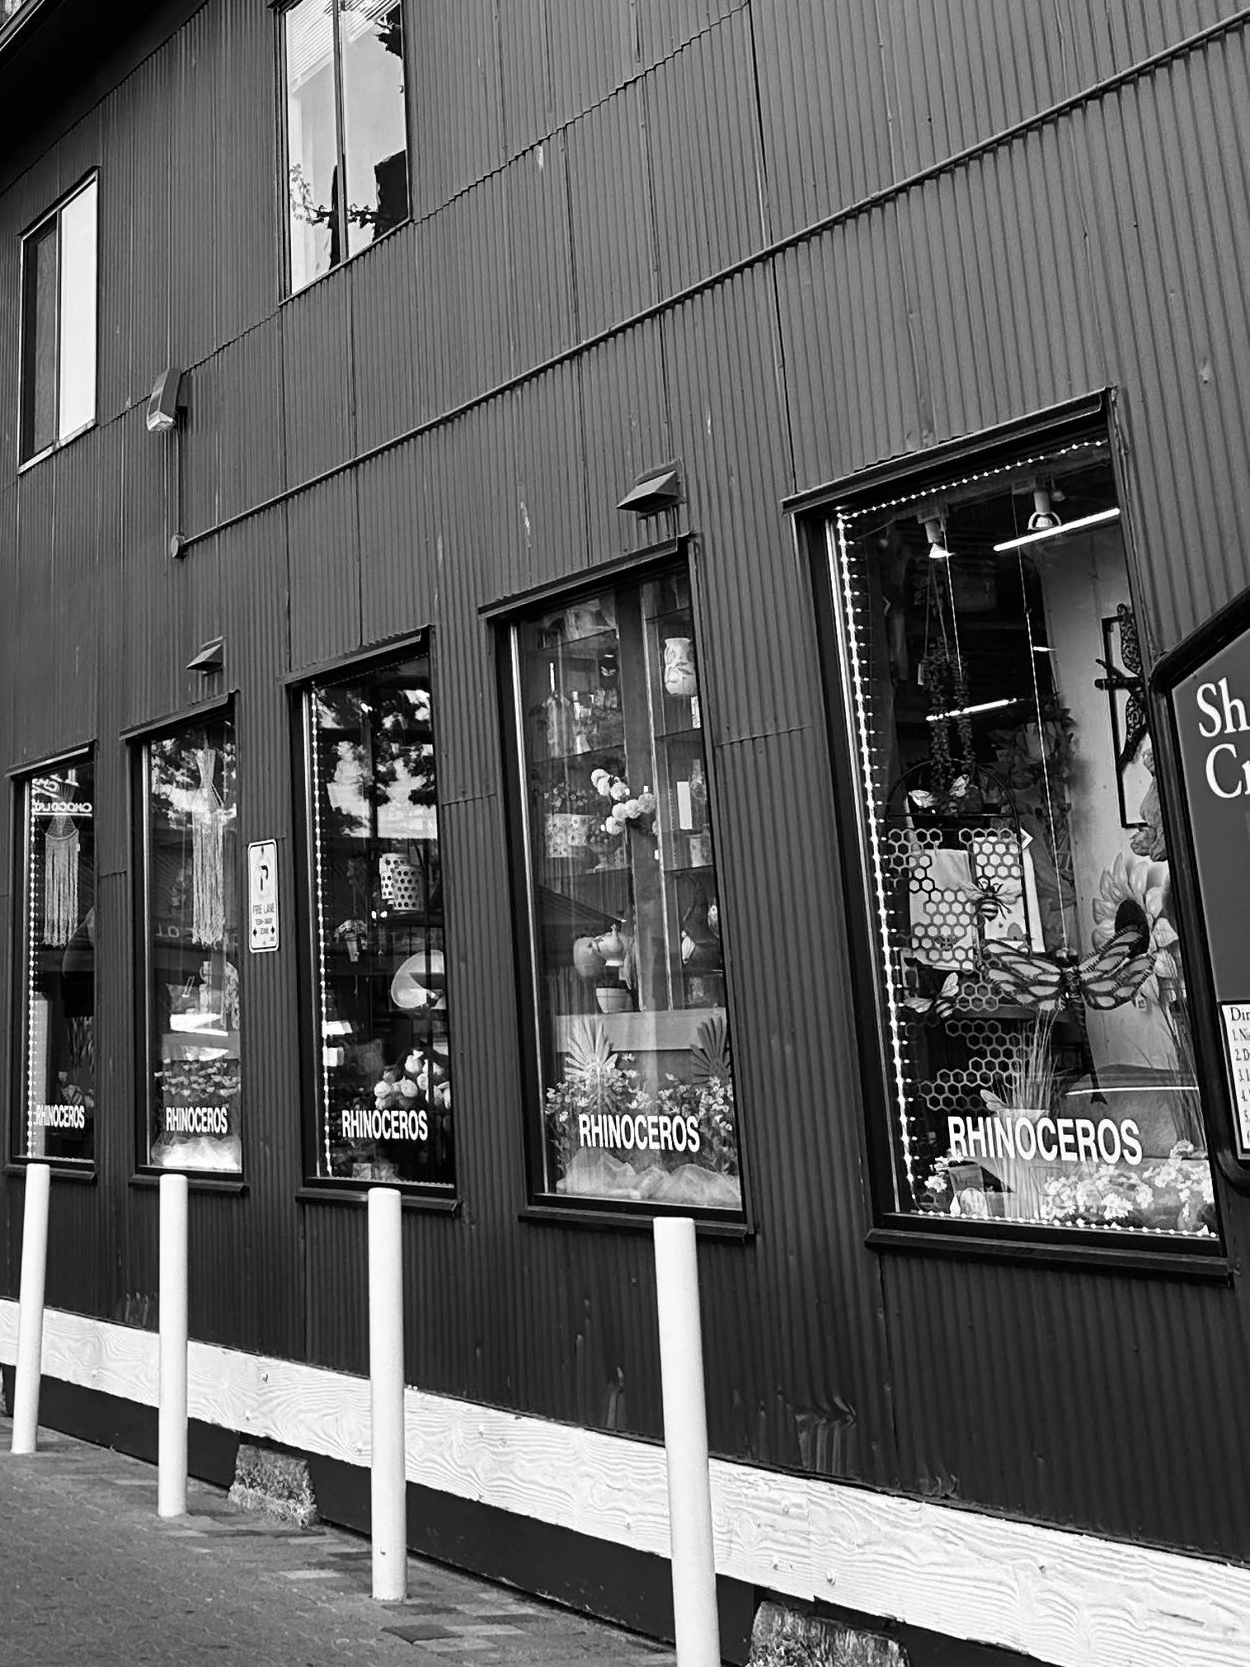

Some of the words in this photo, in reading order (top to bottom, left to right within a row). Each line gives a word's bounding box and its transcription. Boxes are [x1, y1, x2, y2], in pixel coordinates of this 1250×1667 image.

[35, 1104, 86, 1129] RHINOCEROS
[166, 1106, 228, 1134] RHINOCEROS
[341, 1109, 429, 1142] RHINOCEROS
[578, 1114, 700, 1153] RHINOCEROS
[948, 1116, 1143, 1166] RHINOCEROS
